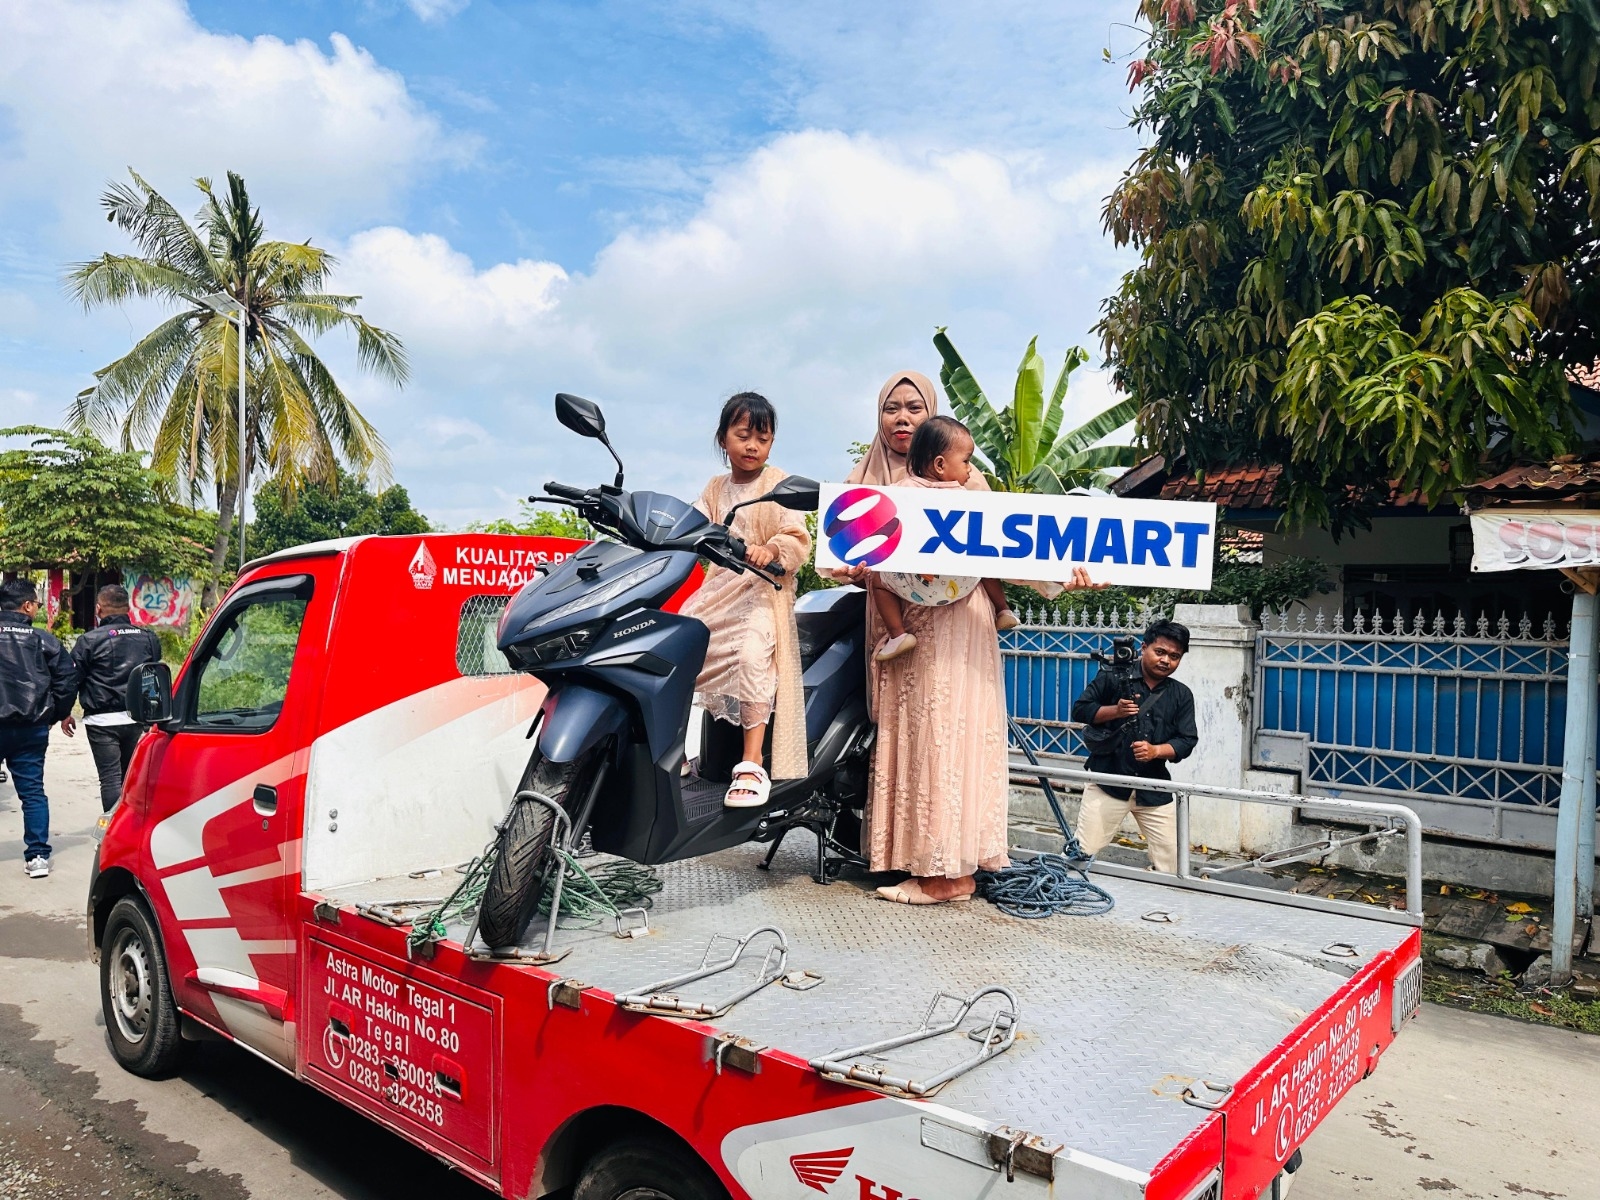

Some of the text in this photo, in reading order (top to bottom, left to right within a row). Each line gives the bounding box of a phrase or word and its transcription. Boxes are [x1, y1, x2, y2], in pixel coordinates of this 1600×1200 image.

[456, 547, 548, 566] KUALITAS
[918, 508, 1210, 568] XLSMART
[1499, 522, 1600, 561] SOS
[613, 619, 656, 639] HONDA
[326, 952, 456, 1024] Astra Motor Tegal 1
[341, 984, 362, 1009] AR
[365, 994, 410, 1031] Hakim
[414, 1015, 460, 1054] No.80
[365, 1016, 409, 1055] Tegal
[1269, 1073, 1288, 1116] AR
[1291, 1040, 1327, 1092] Hakim
[1329, 1004, 1357, 1053] No.80
[1359, 981, 1381, 1019] Tegal
[1329, 1028, 1360, 1077] 350038
